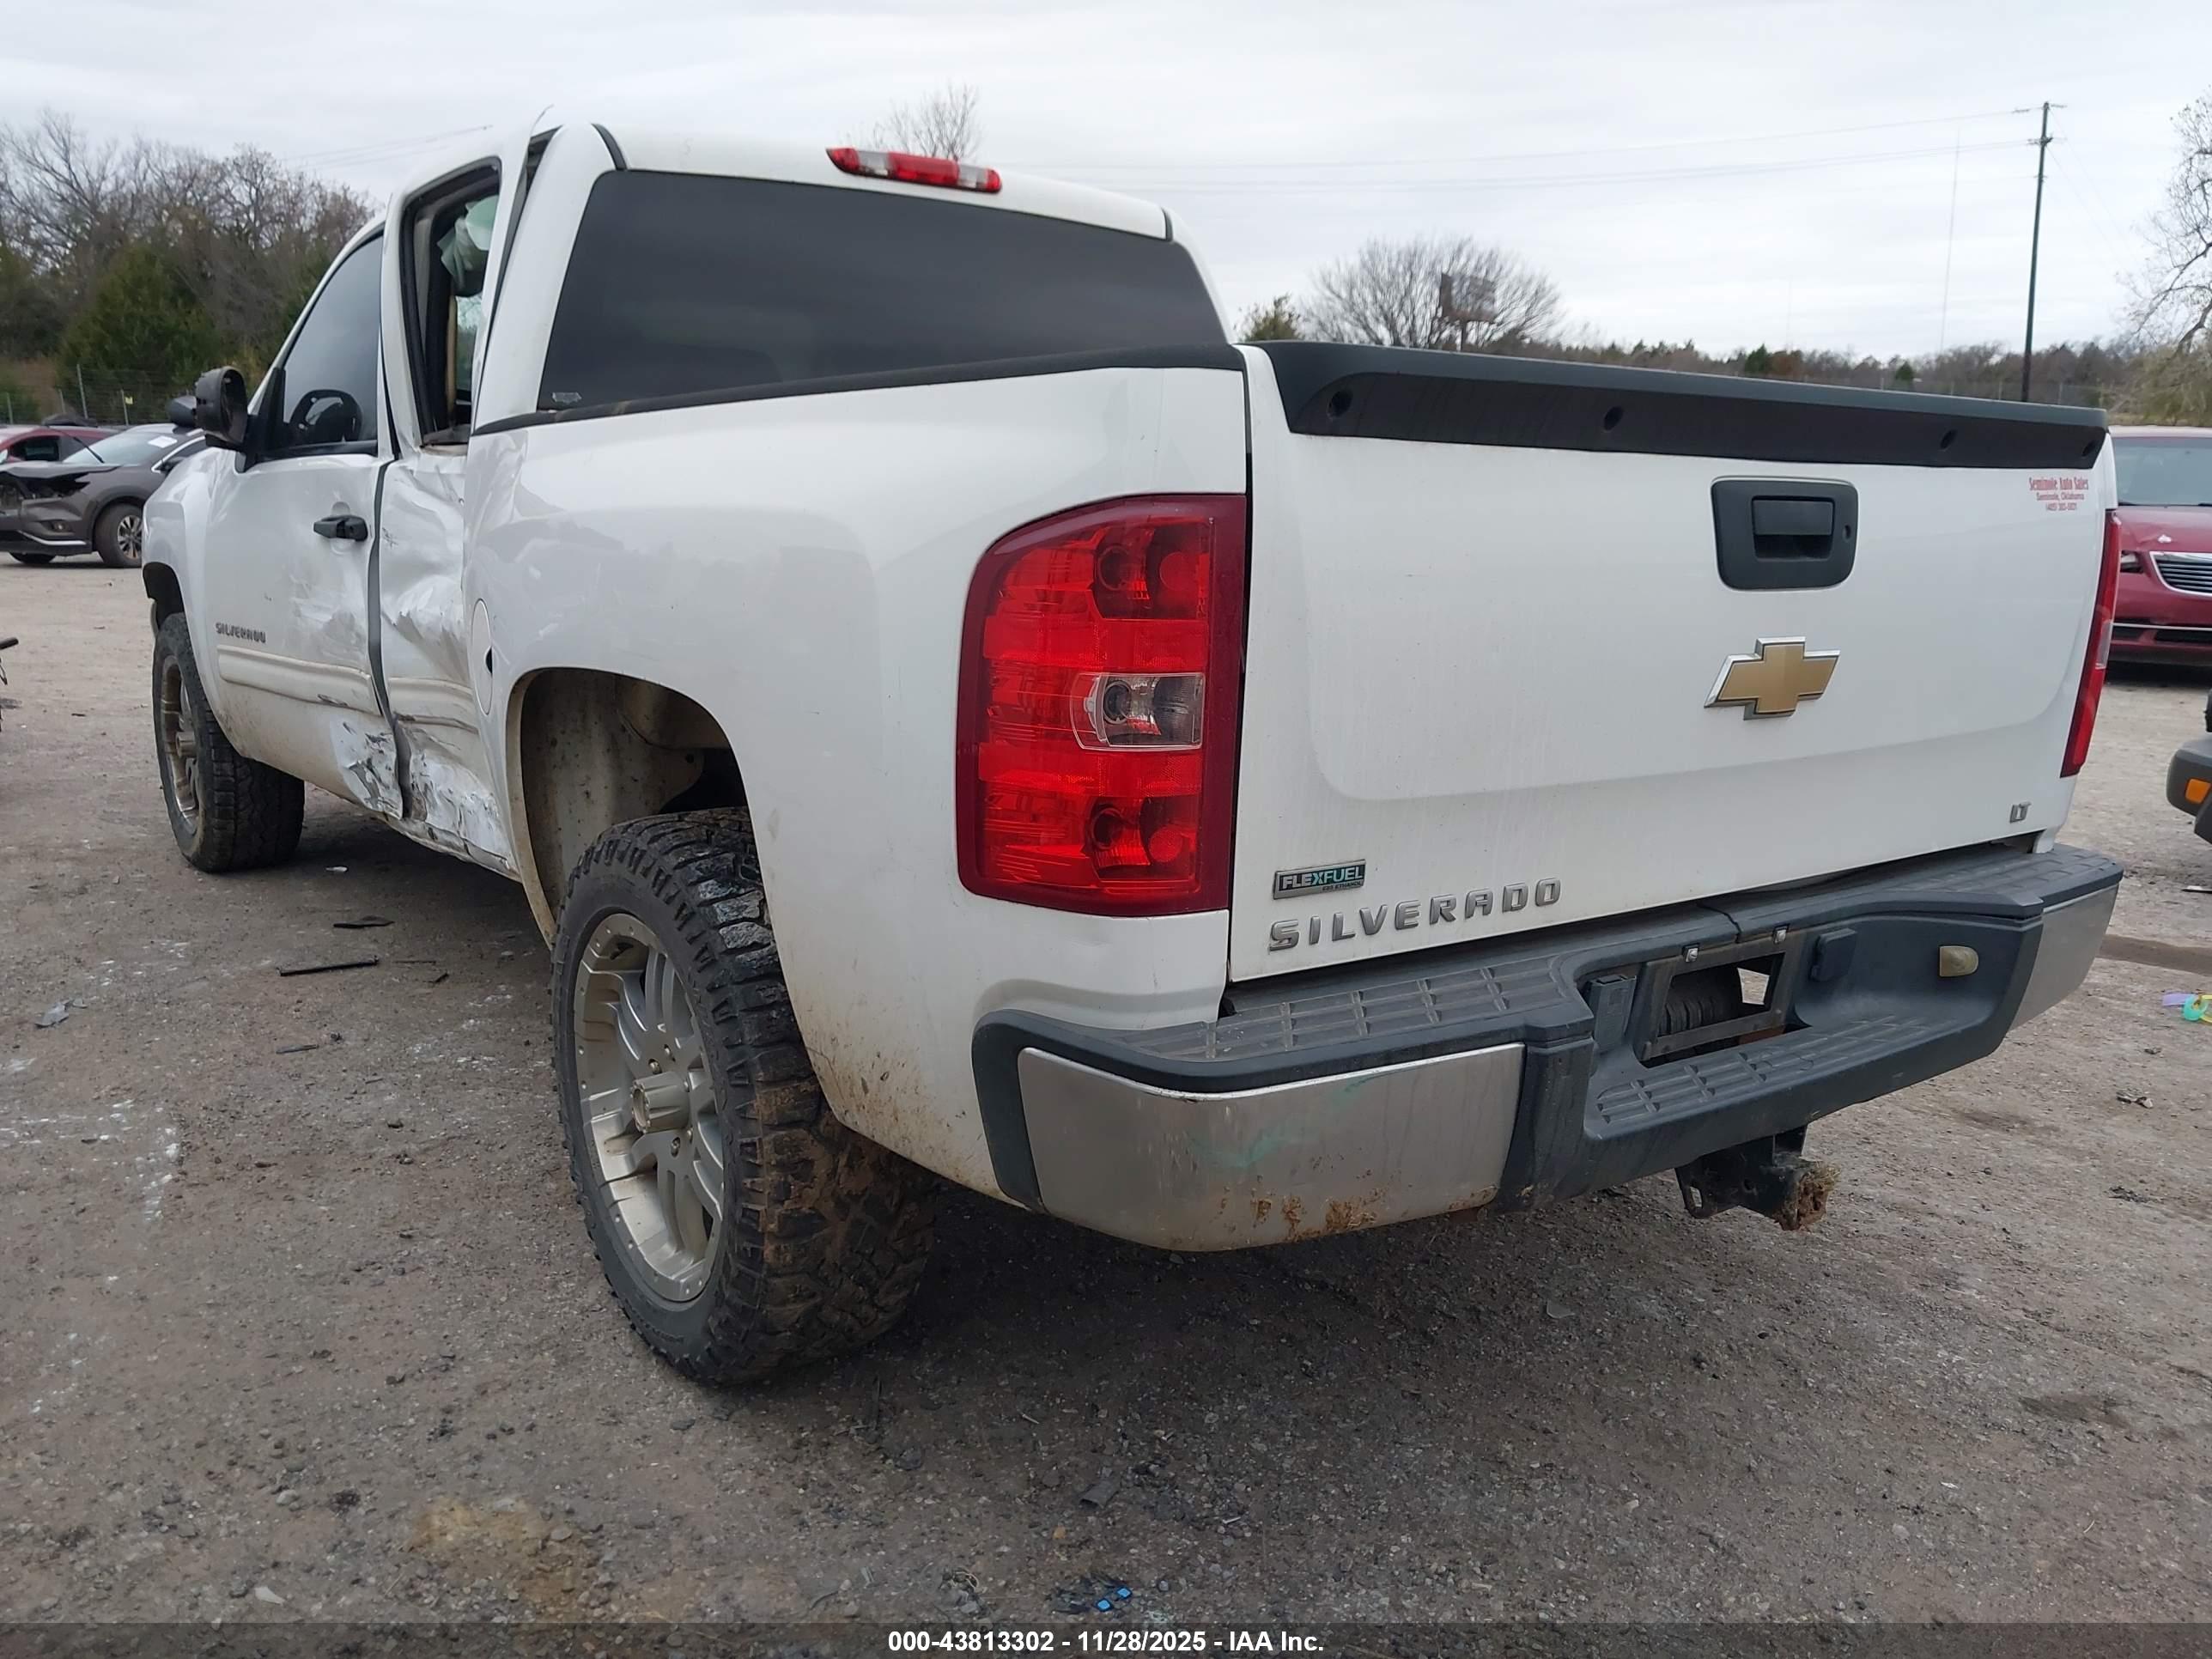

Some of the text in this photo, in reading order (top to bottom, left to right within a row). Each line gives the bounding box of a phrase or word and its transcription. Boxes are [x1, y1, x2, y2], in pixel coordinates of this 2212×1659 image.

[2029, 477, 2089, 491] Seminole Auto Sales
[2009, 801, 2032, 822] LT
[1282, 866, 1364, 889] FLEXFUEL
[1268, 878, 1561, 952] SILVERADO
